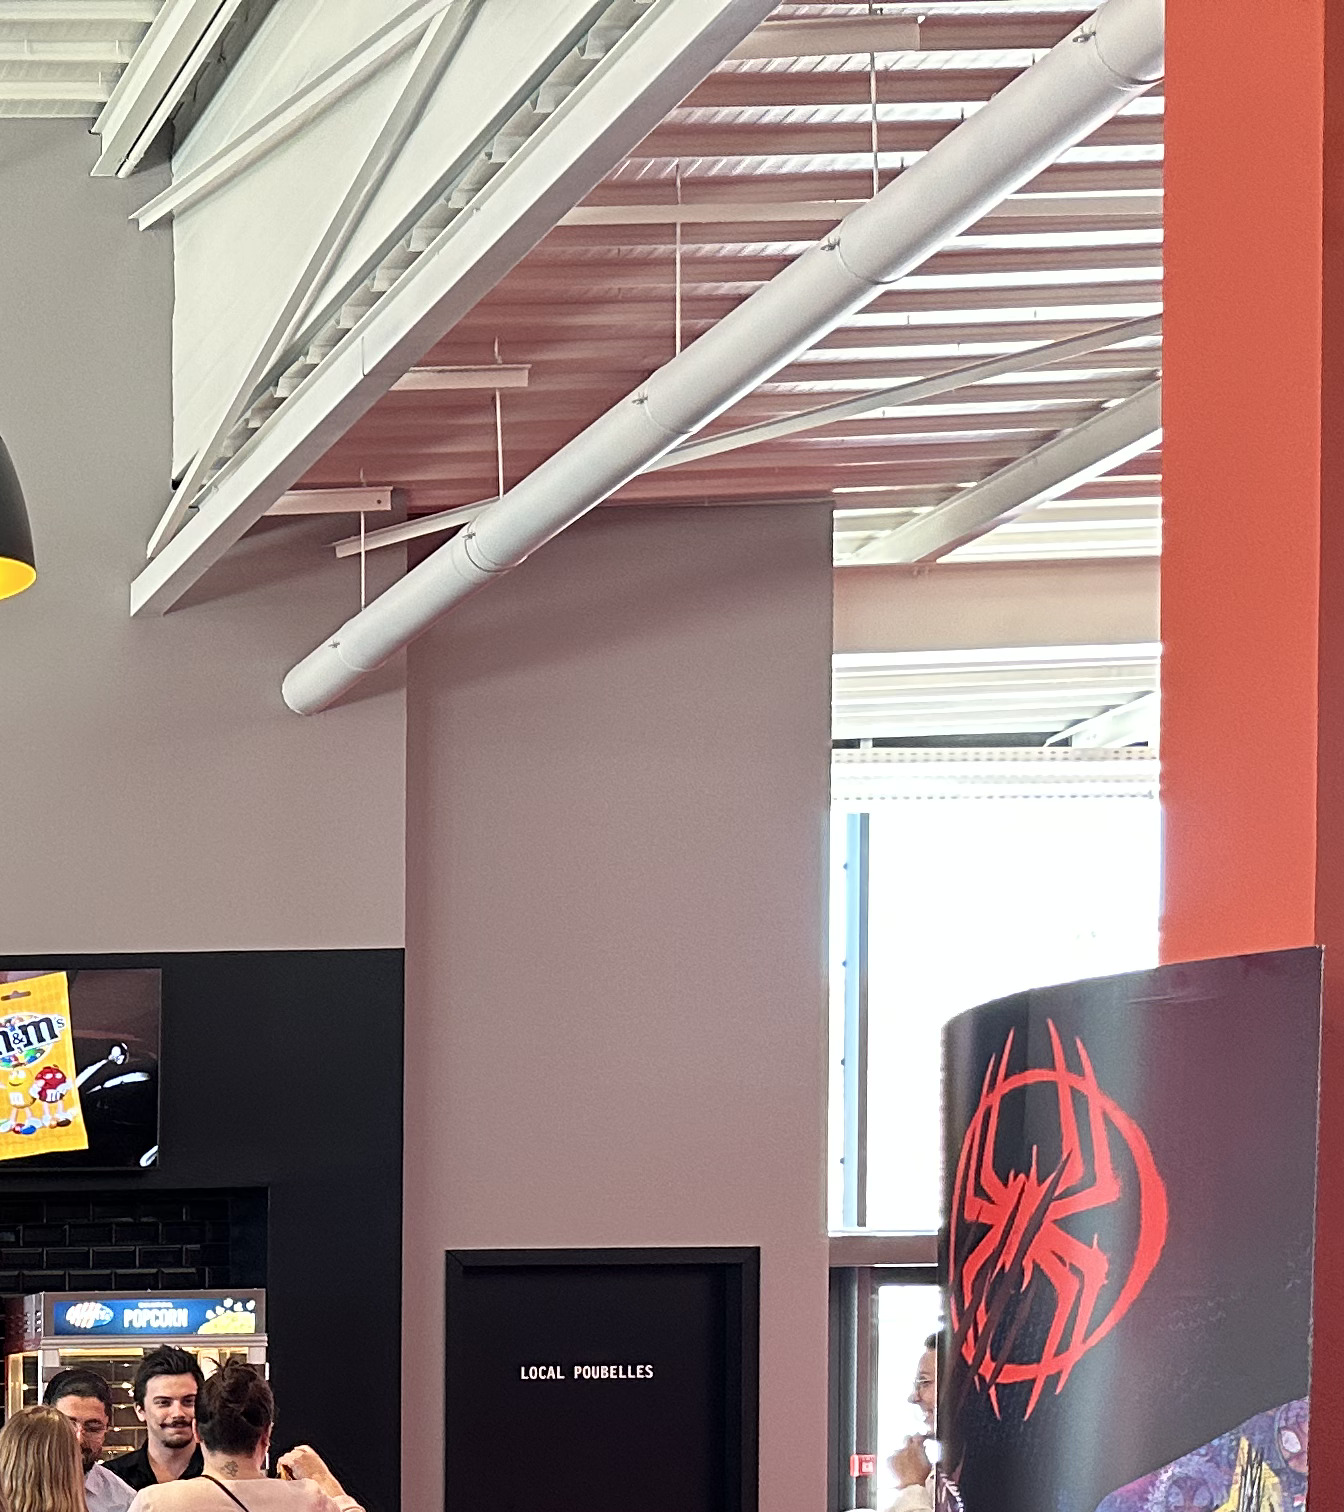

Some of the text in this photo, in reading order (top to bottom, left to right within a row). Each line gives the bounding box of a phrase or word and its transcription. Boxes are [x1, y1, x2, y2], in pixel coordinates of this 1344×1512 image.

[123, 1307, 189, 1329] POPCORN
[520, 1364, 654, 1380] LOCAL POUBELLES
